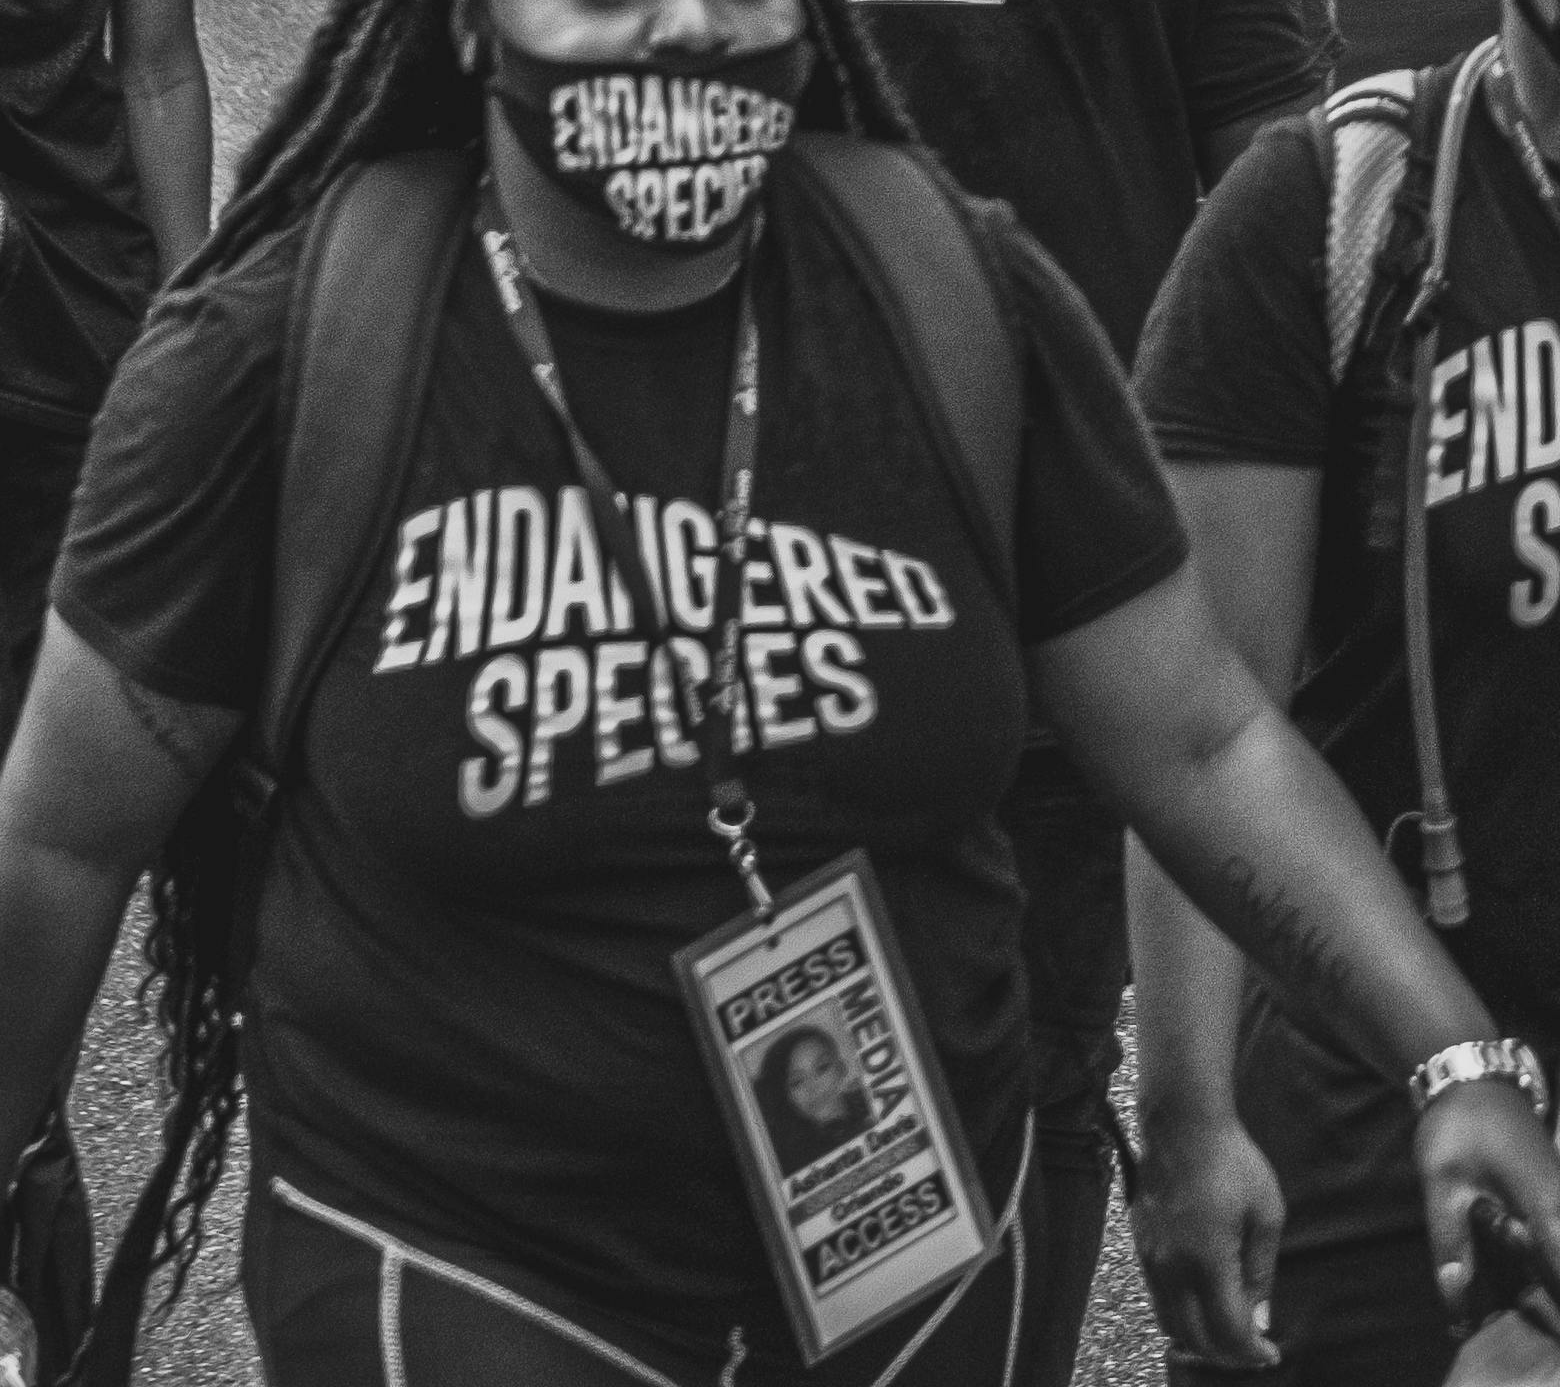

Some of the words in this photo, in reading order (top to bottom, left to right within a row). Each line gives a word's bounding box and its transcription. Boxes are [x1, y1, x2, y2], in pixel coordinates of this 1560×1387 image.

[548, 74, 796, 171] ENDANGERE
[722, 935, 858, 1038] PRESS
[839, 976, 916, 1124] MEDIA
[817, 1179, 942, 1278] ACCESS
